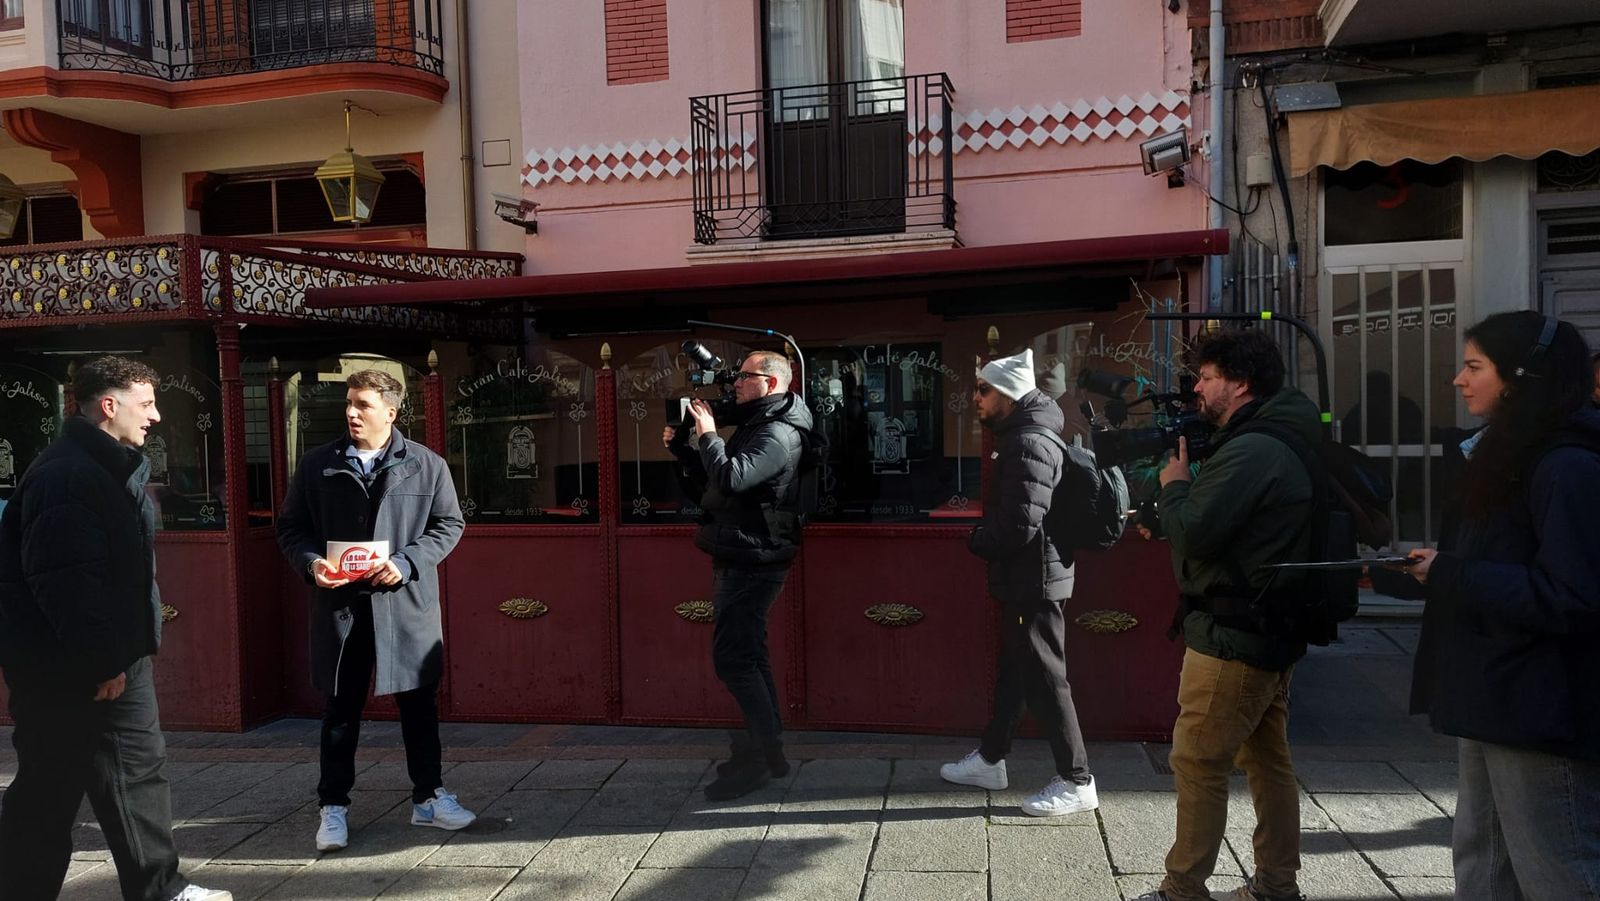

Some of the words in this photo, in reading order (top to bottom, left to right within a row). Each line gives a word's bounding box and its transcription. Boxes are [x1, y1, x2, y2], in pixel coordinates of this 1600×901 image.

[1075, 333, 1115, 357] Café
[863, 343, 902, 366] Café
[899, 350, 960, 382] Jalisco
[159, 374, 206, 403] Jalisco
[456, 372, 496, 398] Gran
[497, 356, 529, 379] Café
[528, 363, 580, 398] Jalisco
[632, 367, 673, 393] Gran
[7, 380, 50, 409] Jalisco
[504, 506, 525, 516] desde
[525, 506, 543, 516] 1933
[870, 504, 893, 514] desde
[895, 504, 915, 514] 1933
